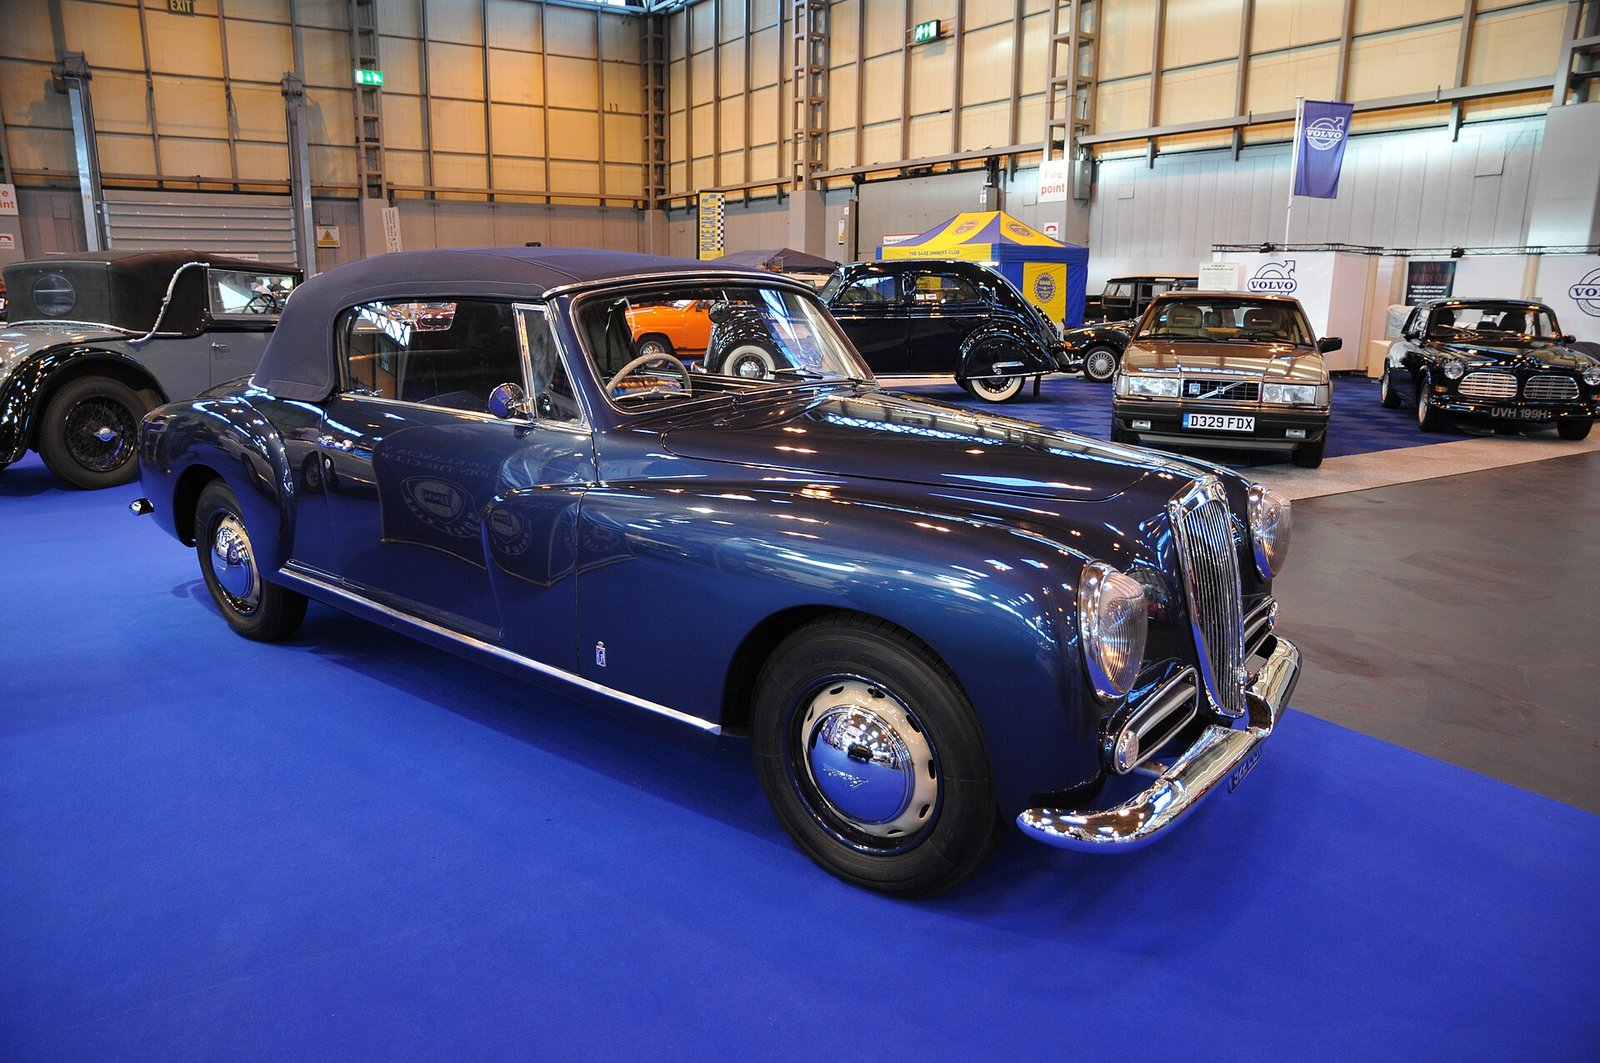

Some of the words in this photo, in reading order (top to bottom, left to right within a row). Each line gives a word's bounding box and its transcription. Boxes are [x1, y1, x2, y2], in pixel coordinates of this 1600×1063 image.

[170, 0, 191, 12] EXIT
[1306, 129, 1342, 139] VOLVO
[1041, 182, 1065, 196] point
[701, 206, 715, 214] UK
[701, 216, 715, 228] CAR
[701, 230, 715, 251] POLICE
[1250, 281, 1293, 289] VOLVO
[1573, 288, 1600, 297] VO
[1491, 407, 1517, 418] UVH
[1520, 408, 1547, 419] 199H
[1190, 415, 1224, 428] D329
[1227, 417, 1253, 430] FDX
